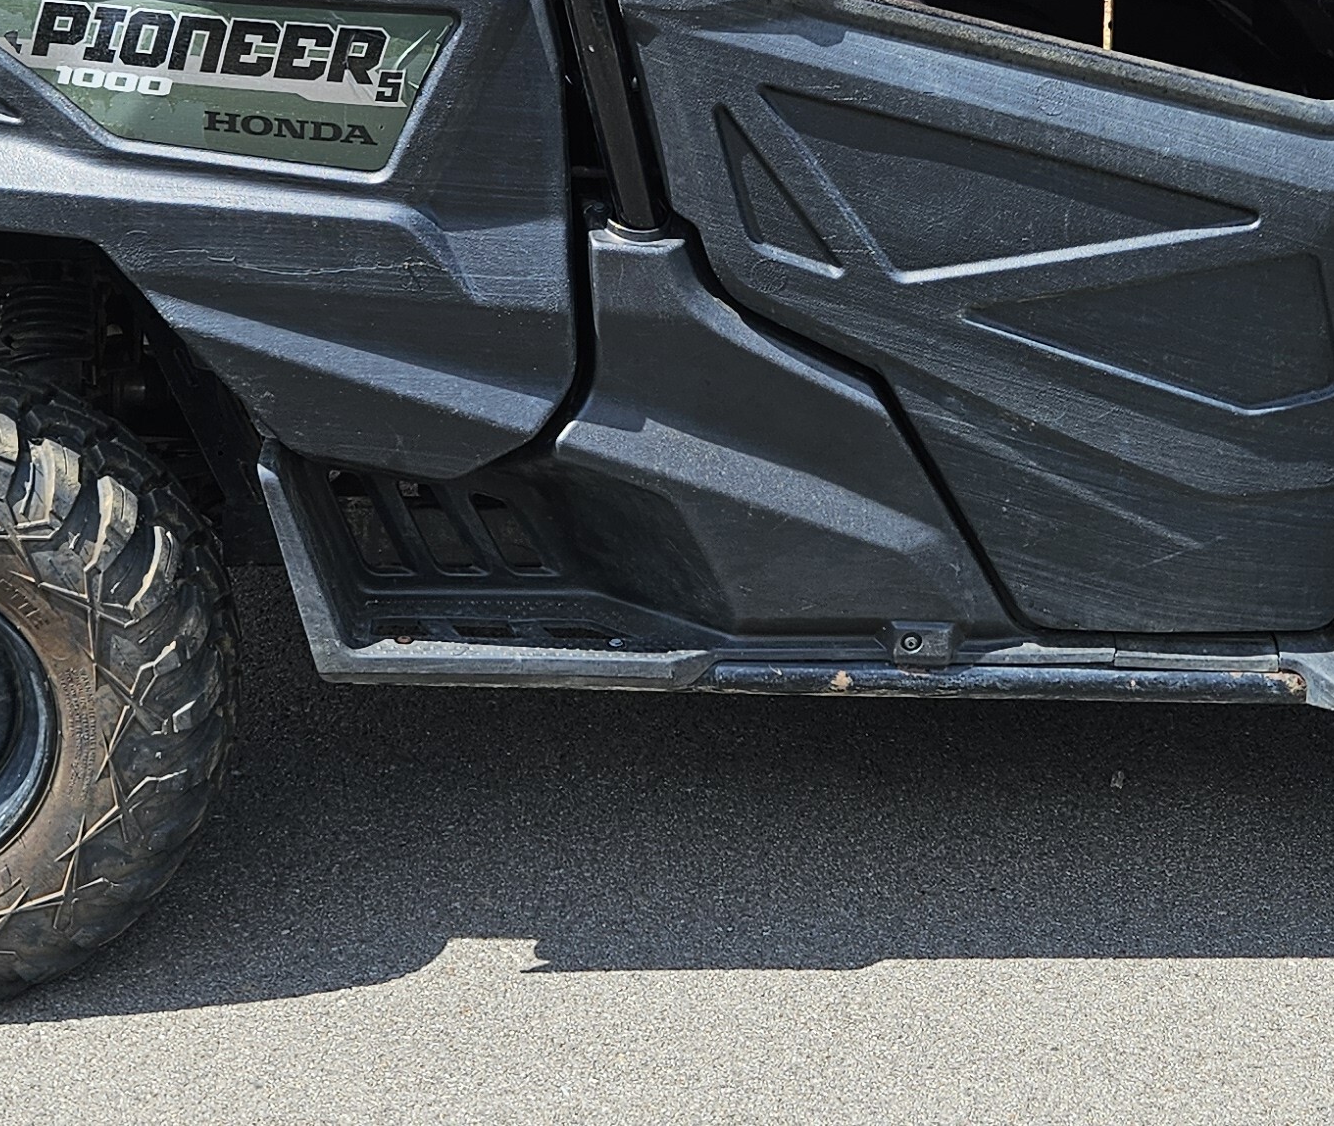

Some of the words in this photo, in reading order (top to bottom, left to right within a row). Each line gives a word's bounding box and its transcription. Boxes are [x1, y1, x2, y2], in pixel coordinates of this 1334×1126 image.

[31, 0, 390, 86] PIONEER
[373, 69, 406, 104] 5
[55, 65, 174, 97] 1000
[203, 110, 378, 146] HONDA
